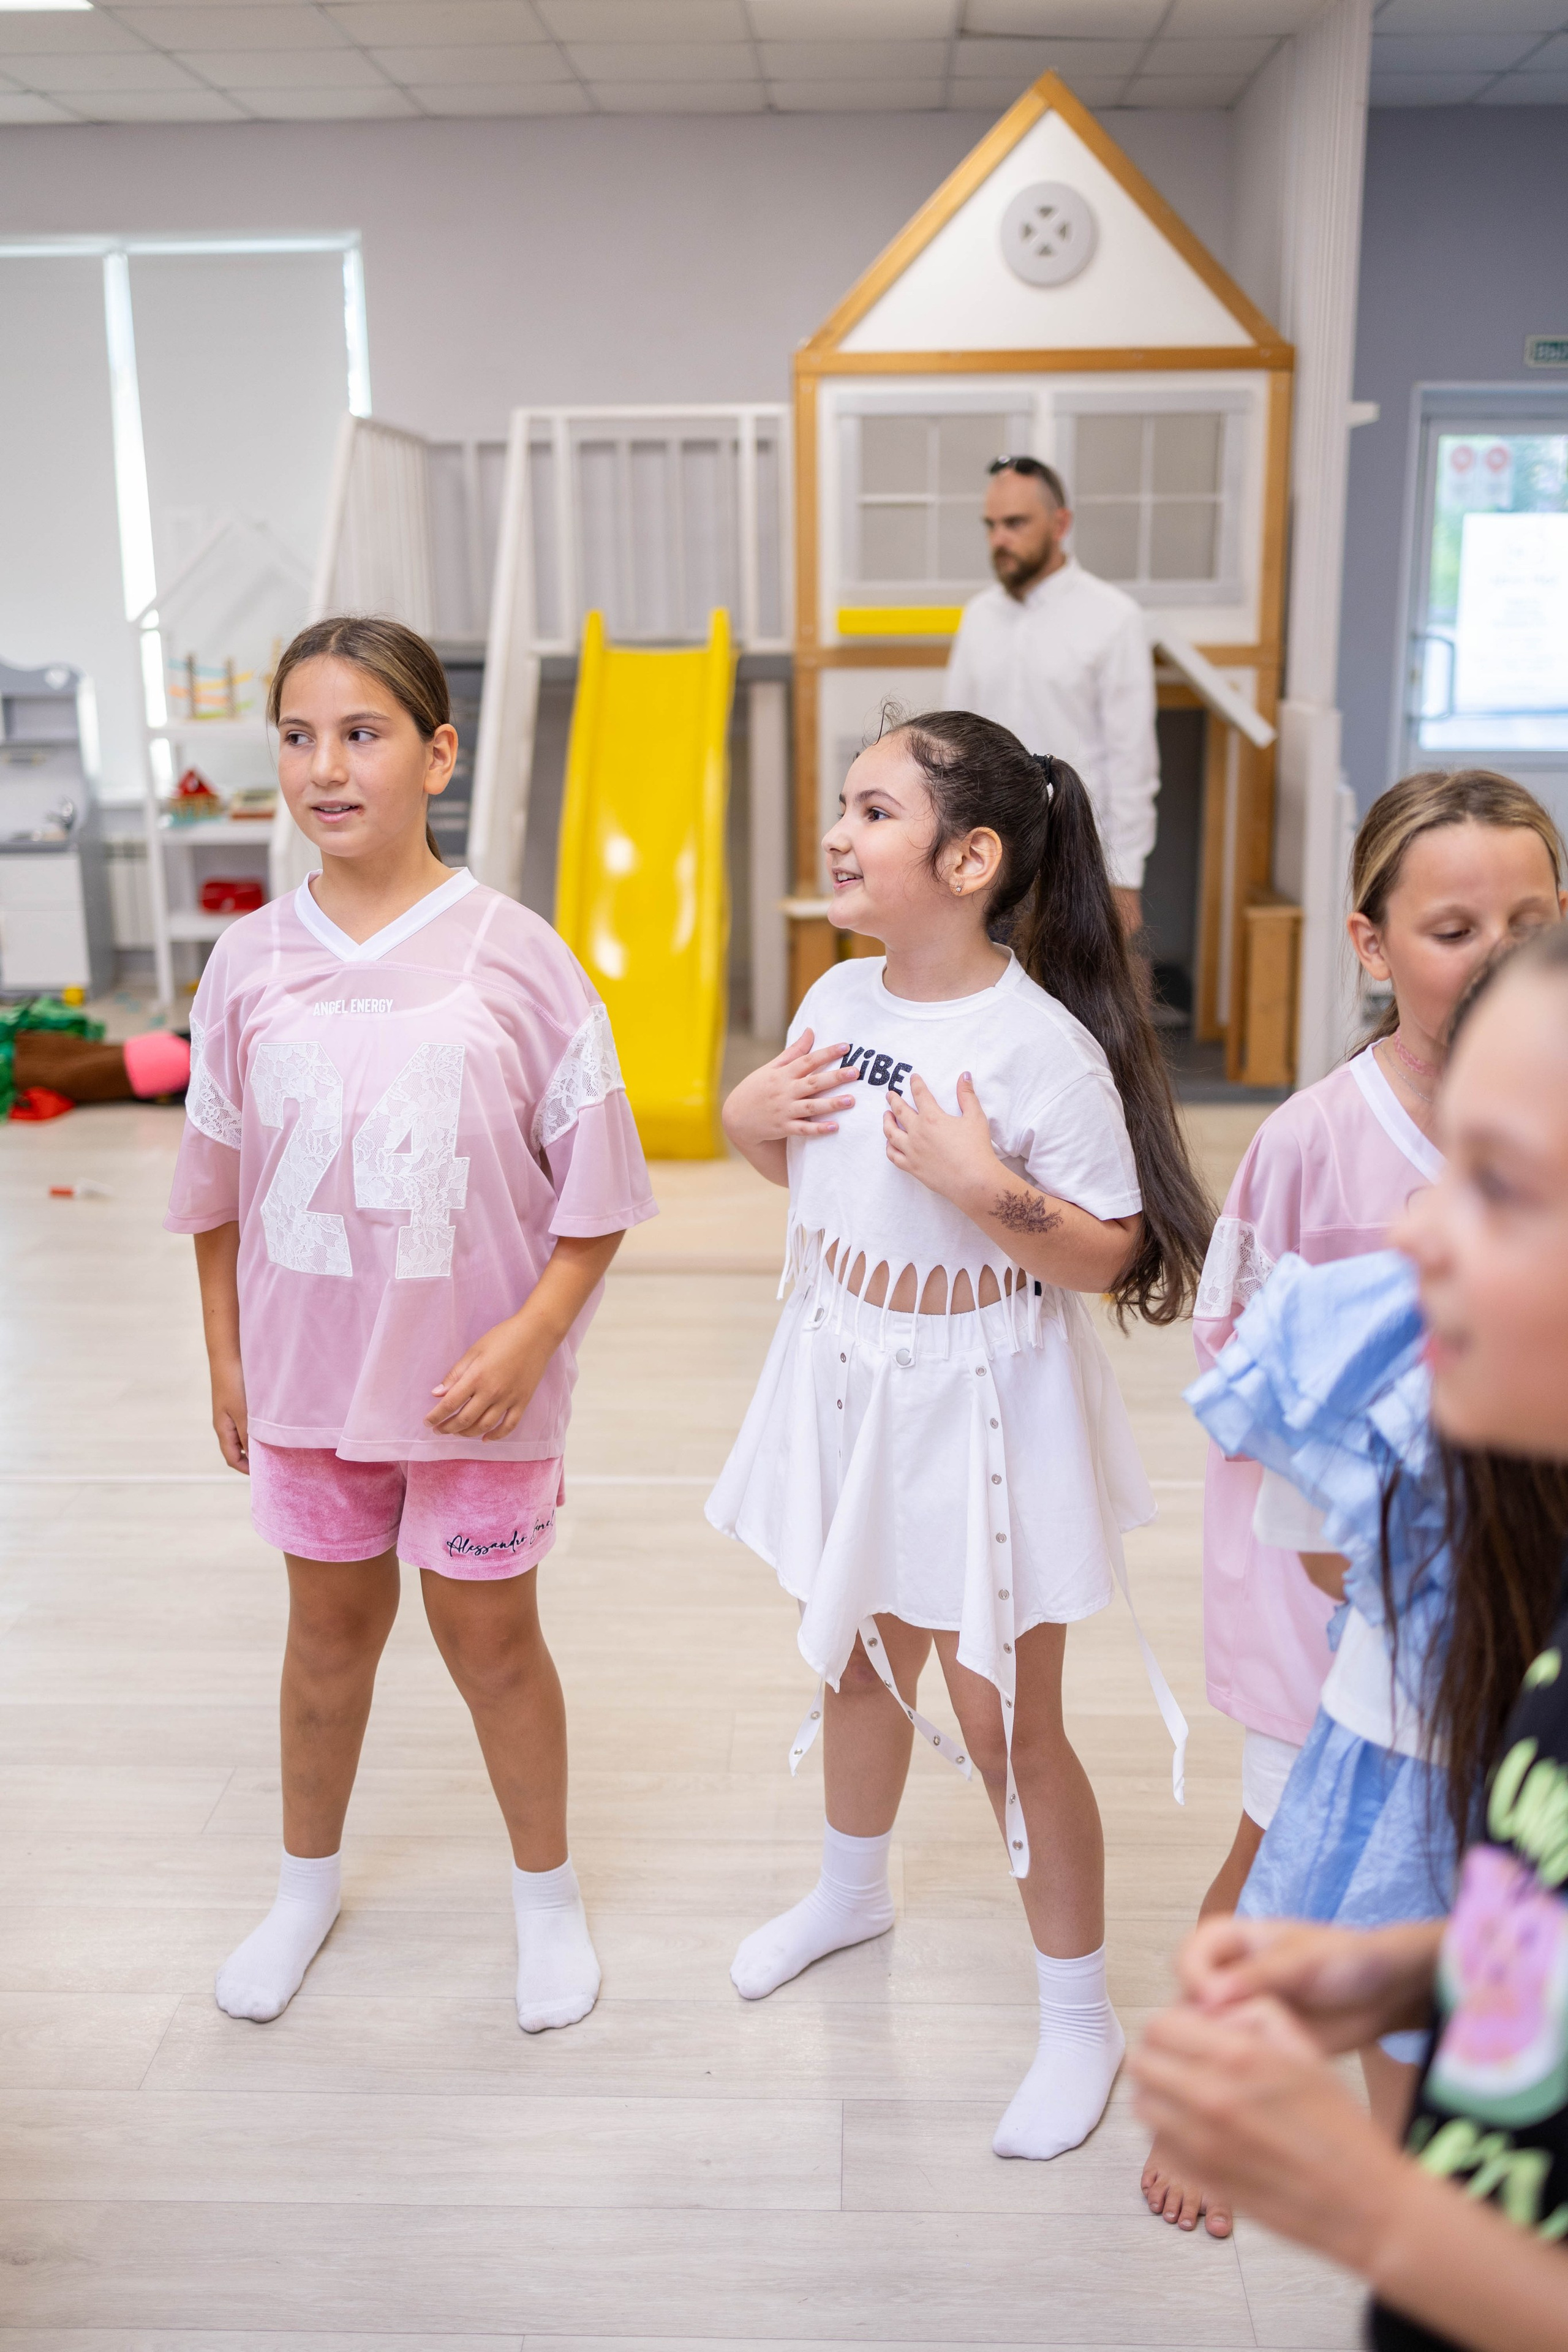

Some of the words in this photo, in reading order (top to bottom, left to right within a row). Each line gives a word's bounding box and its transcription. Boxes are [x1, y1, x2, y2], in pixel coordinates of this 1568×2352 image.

[313, 1000, 348, 1016] ANGEL
[350, 998, 393, 1014] ENERGY
[249, 1042, 470, 1280] 24
[447, 1530, 527, 1557] Alessandro
